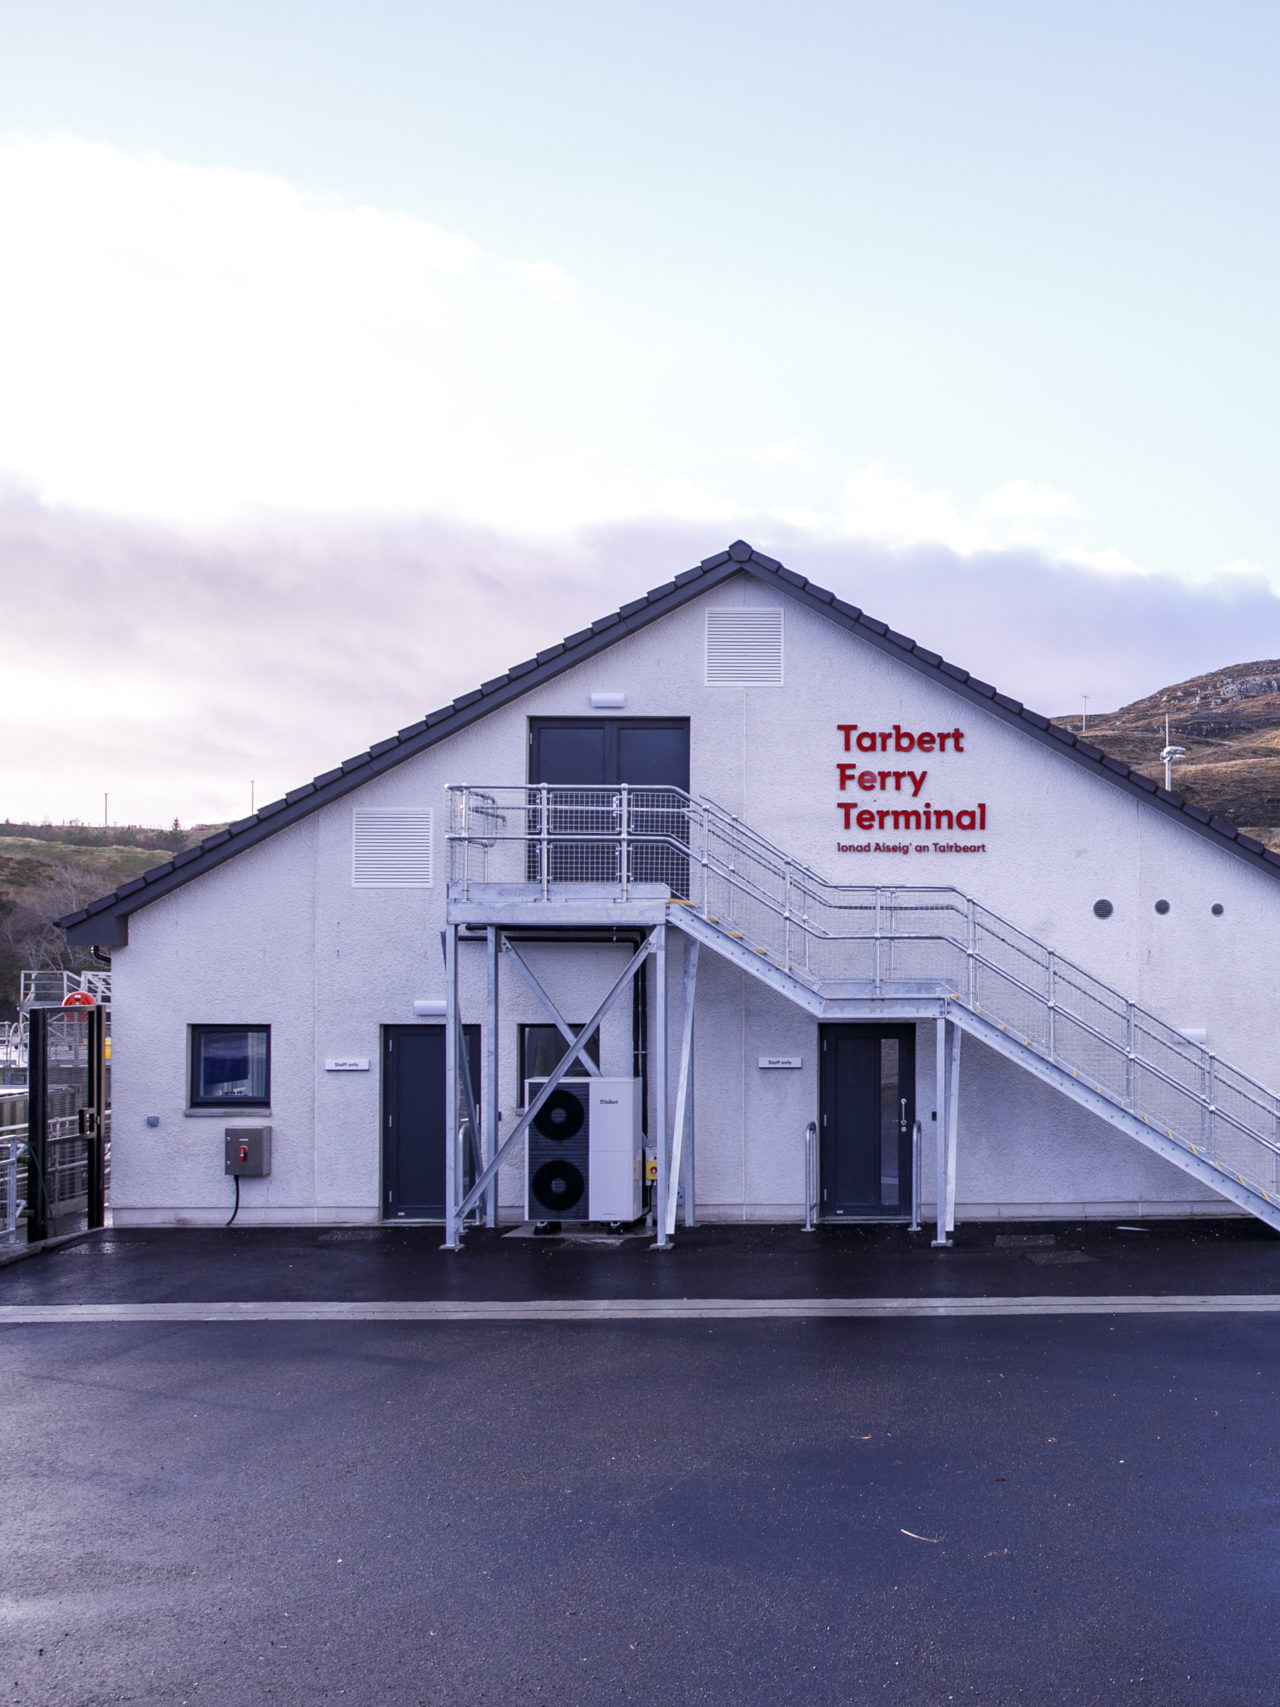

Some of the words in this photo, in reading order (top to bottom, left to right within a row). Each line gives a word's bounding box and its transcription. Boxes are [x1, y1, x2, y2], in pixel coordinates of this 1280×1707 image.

[837, 724, 964, 752] Tarbert
[836, 763, 928, 797] Ferry
[837, 802, 986, 830] Terminal
[836, 842, 871, 853] Ionad
[914, 844, 930, 853] an
[932, 842, 986, 853] Tairbeart
